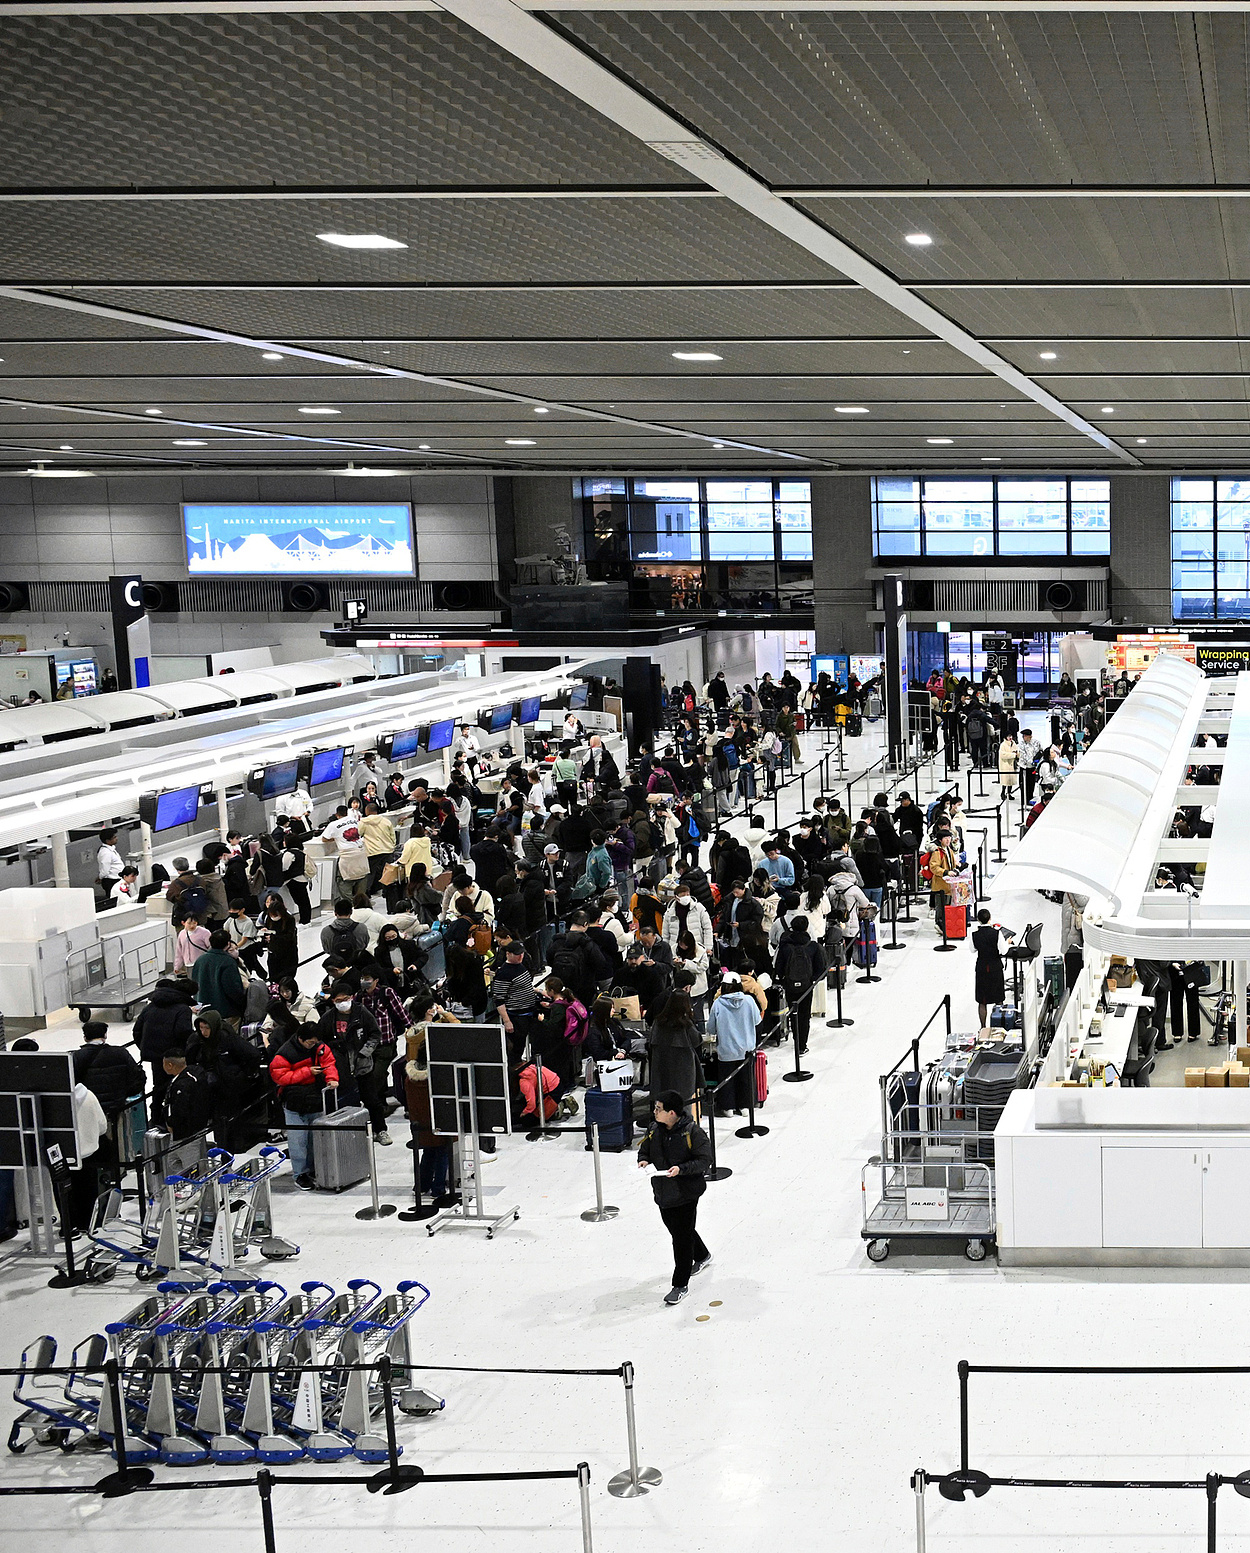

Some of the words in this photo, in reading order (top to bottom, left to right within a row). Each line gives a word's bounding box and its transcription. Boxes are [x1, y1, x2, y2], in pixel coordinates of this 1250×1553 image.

[124, 580, 140, 607] C
[1000, 640, 1007, 649] 2
[1199, 650, 1249, 661] Wrapping
[986, 653, 1008, 670] 3F
[1202, 660, 1240, 669] Service
